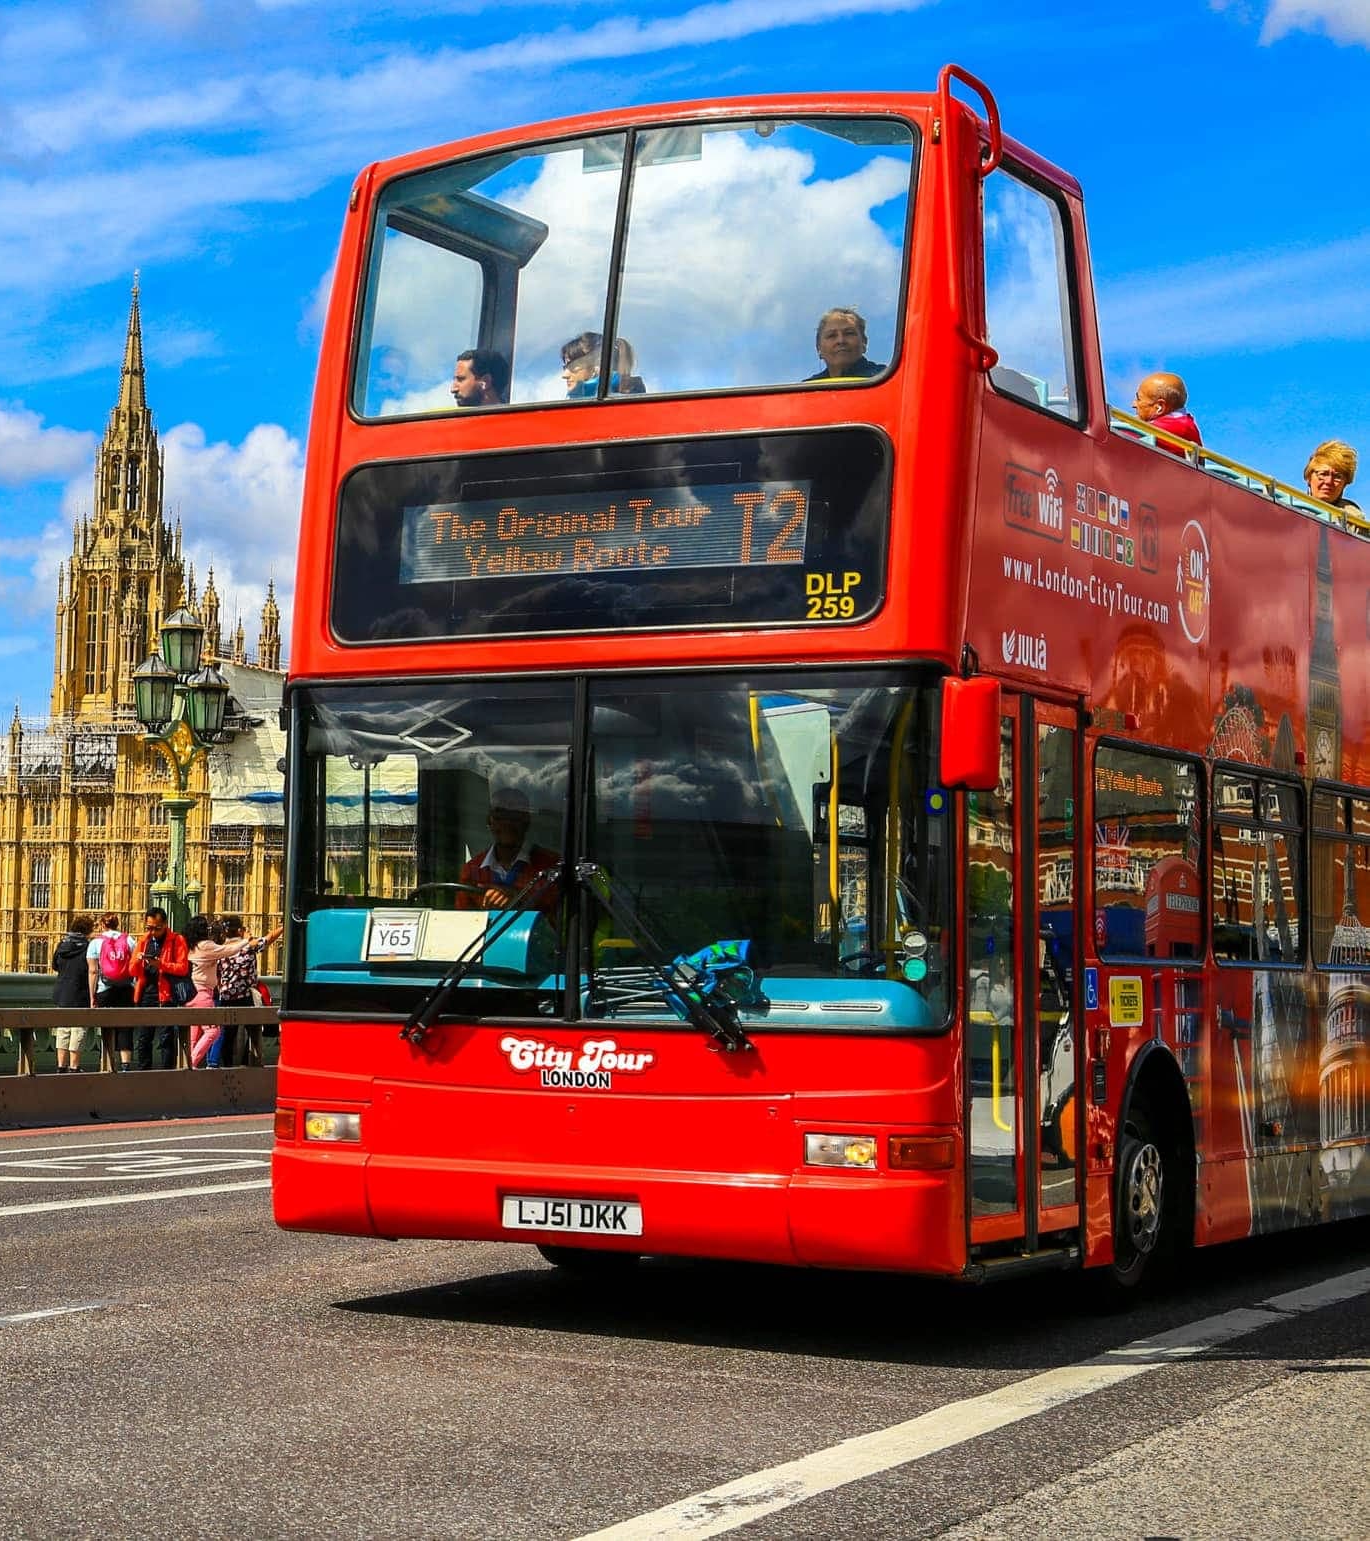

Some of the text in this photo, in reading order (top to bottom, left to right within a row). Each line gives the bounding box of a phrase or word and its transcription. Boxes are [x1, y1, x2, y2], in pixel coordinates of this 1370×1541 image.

[430, 498, 711, 545] The Original Tour
[733, 488, 806, 565] T2
[1038, 491, 1063, 531] WiFi
[465, 538, 671, 577] Yellow Route
[1190, 548, 1204, 580] ON
[805, 571, 862, 596] DLP
[1003, 555, 1169, 625] www.London-CityTour.com
[805, 596, 855, 619] 259
[380, 929, 411, 946] Y65
[500, 1036, 654, 1072] City Tour
[542, 1070, 611, 1089] LONDON
[518, 1200, 628, 1231] LJ51 DKK
